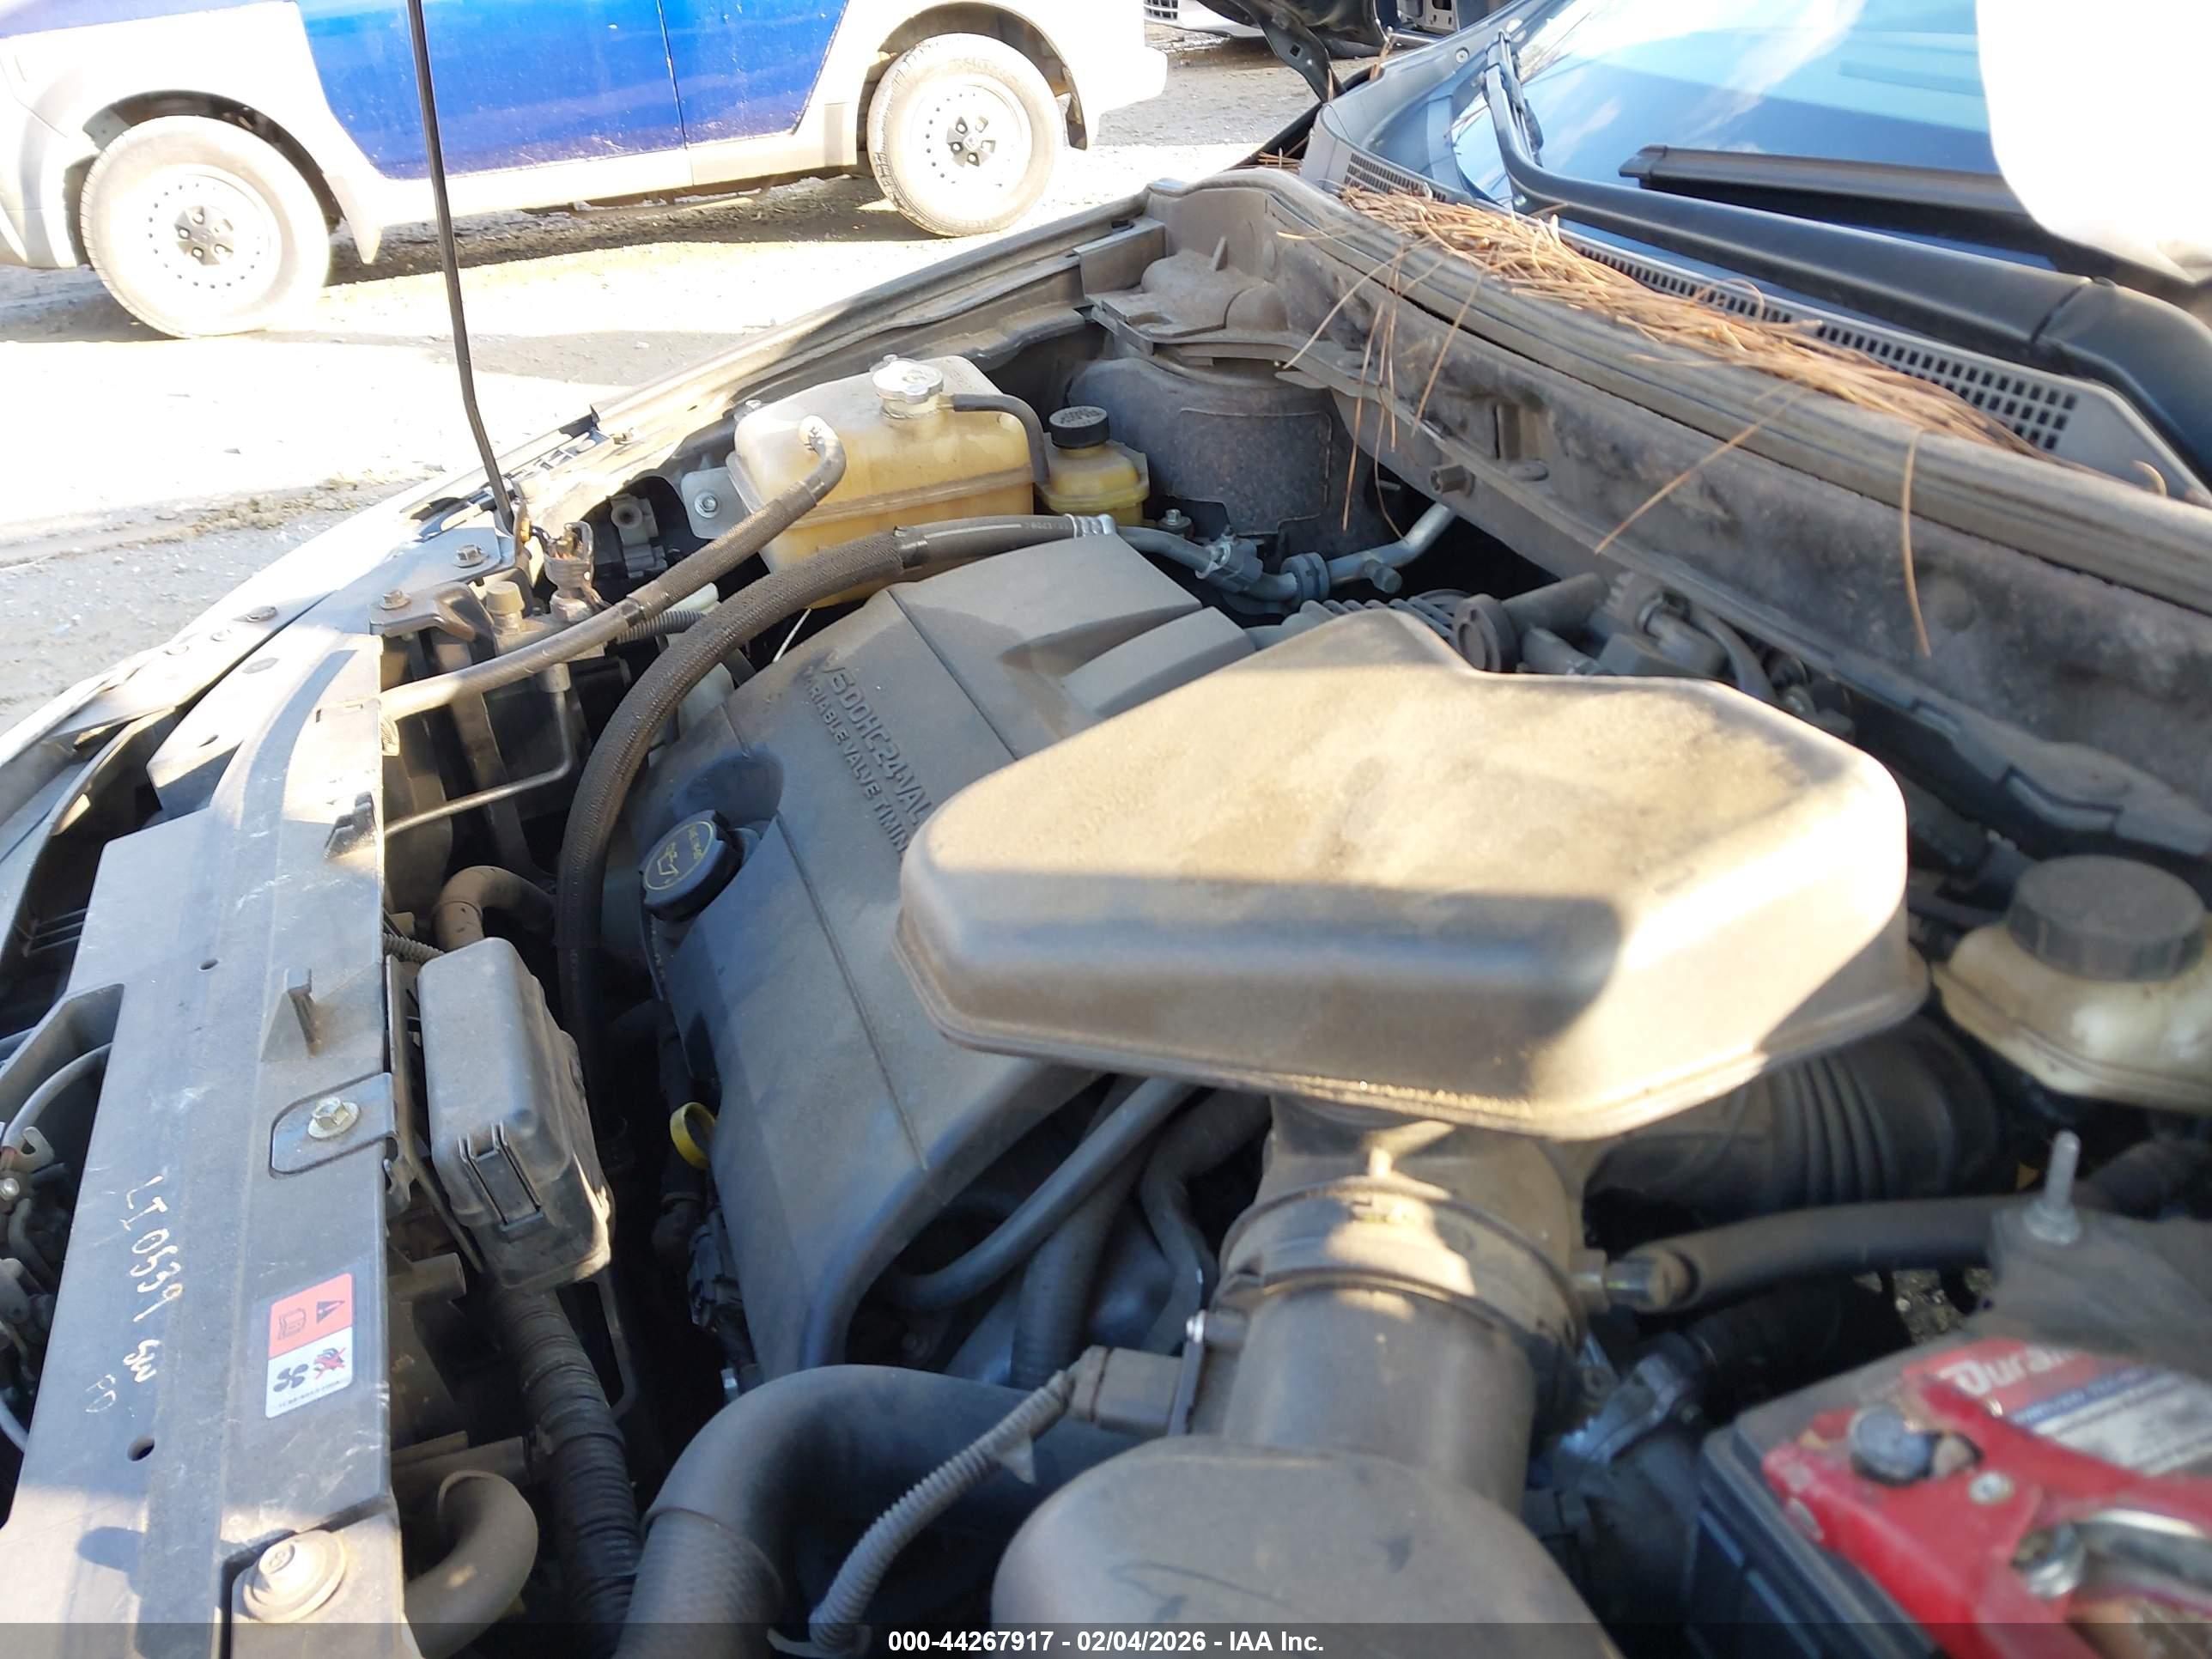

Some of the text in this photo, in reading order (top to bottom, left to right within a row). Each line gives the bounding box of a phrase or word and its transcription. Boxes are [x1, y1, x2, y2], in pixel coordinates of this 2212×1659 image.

[803, 667, 910, 854] VARIABLE VALVE TIMIN
